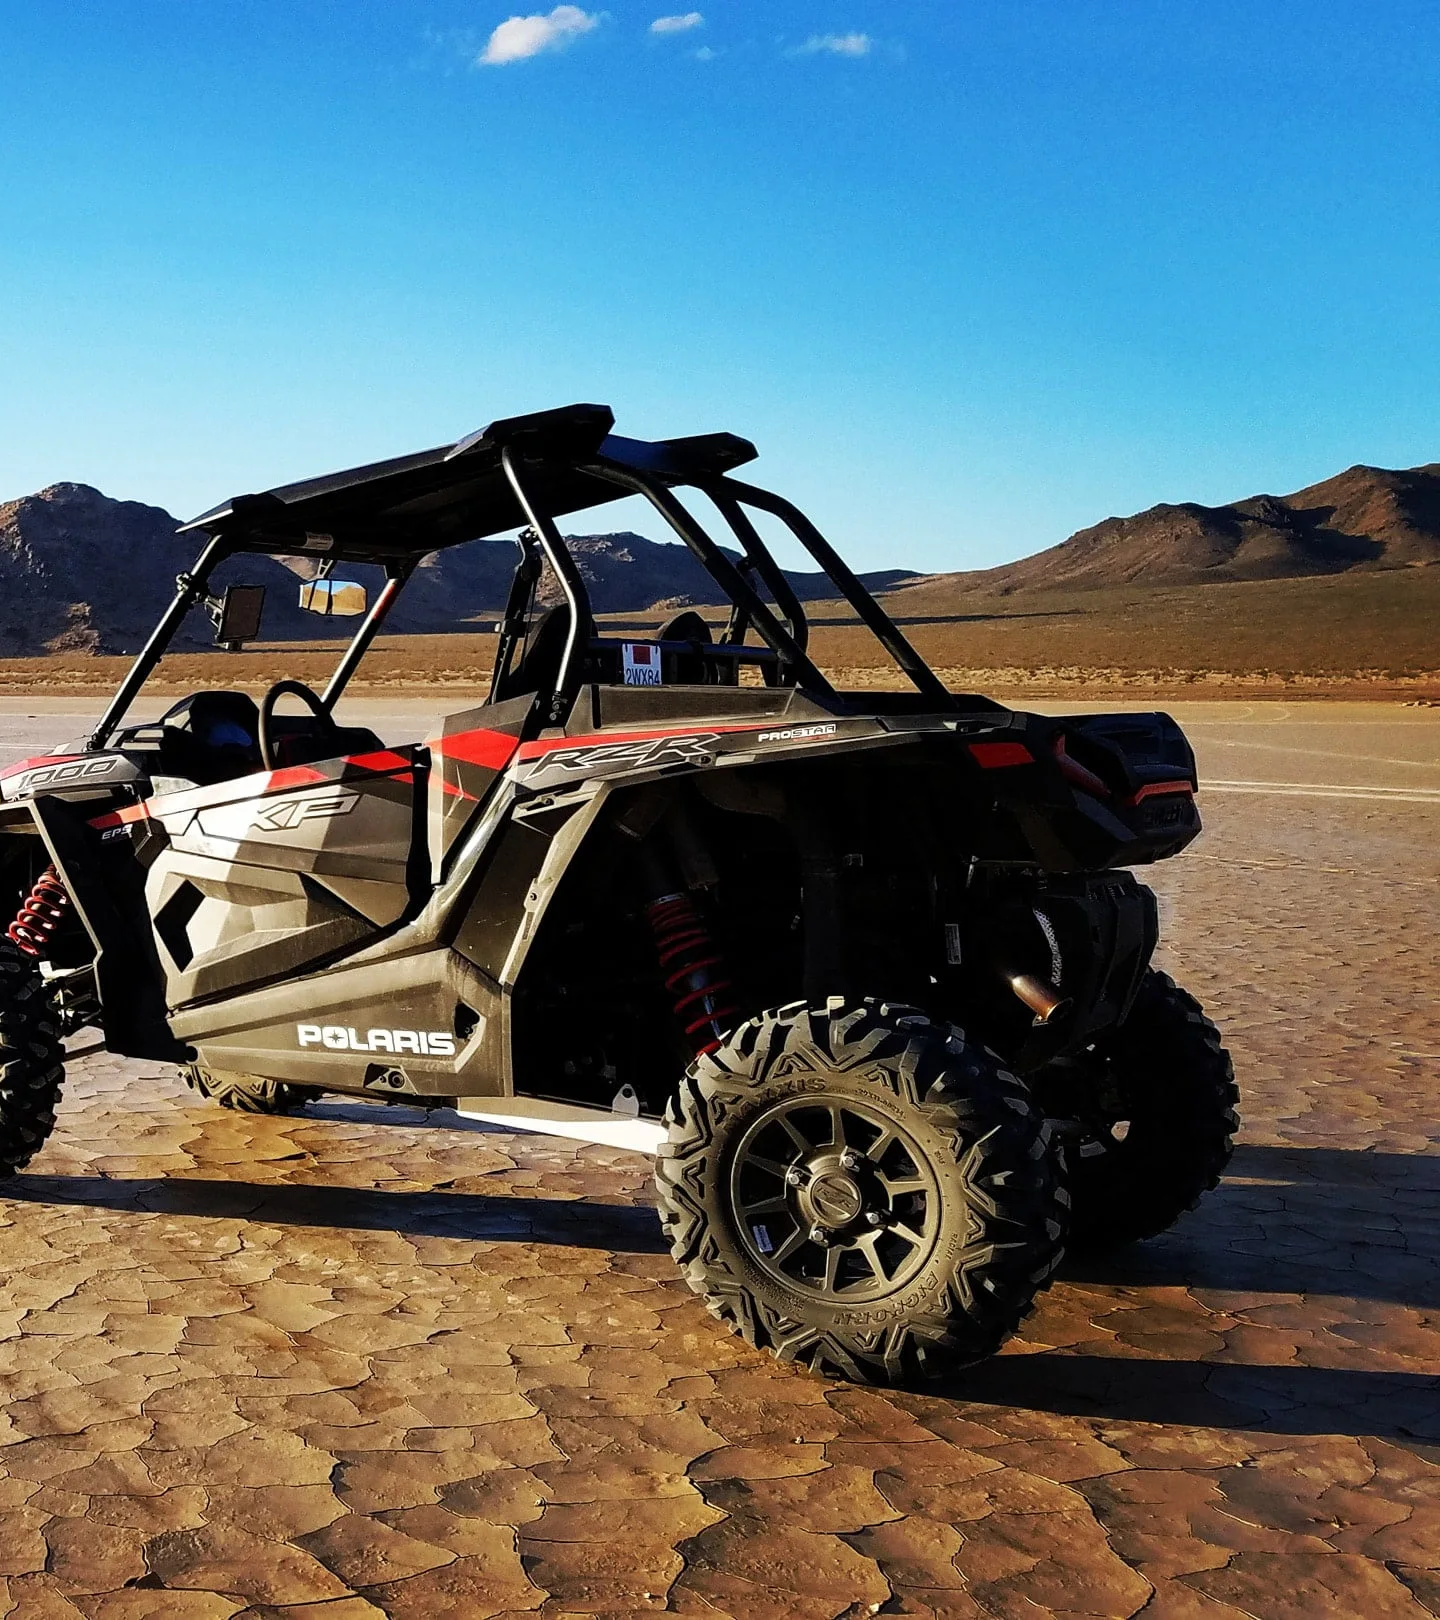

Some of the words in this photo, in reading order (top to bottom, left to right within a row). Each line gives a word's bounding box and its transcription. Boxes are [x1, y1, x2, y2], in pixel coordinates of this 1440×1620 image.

[758, 724, 837, 742] PROSTAR
[521, 732, 722, 782] RZR
[18, 759, 118, 789] 1000
[297, 1024, 456, 1056] POLARIS
